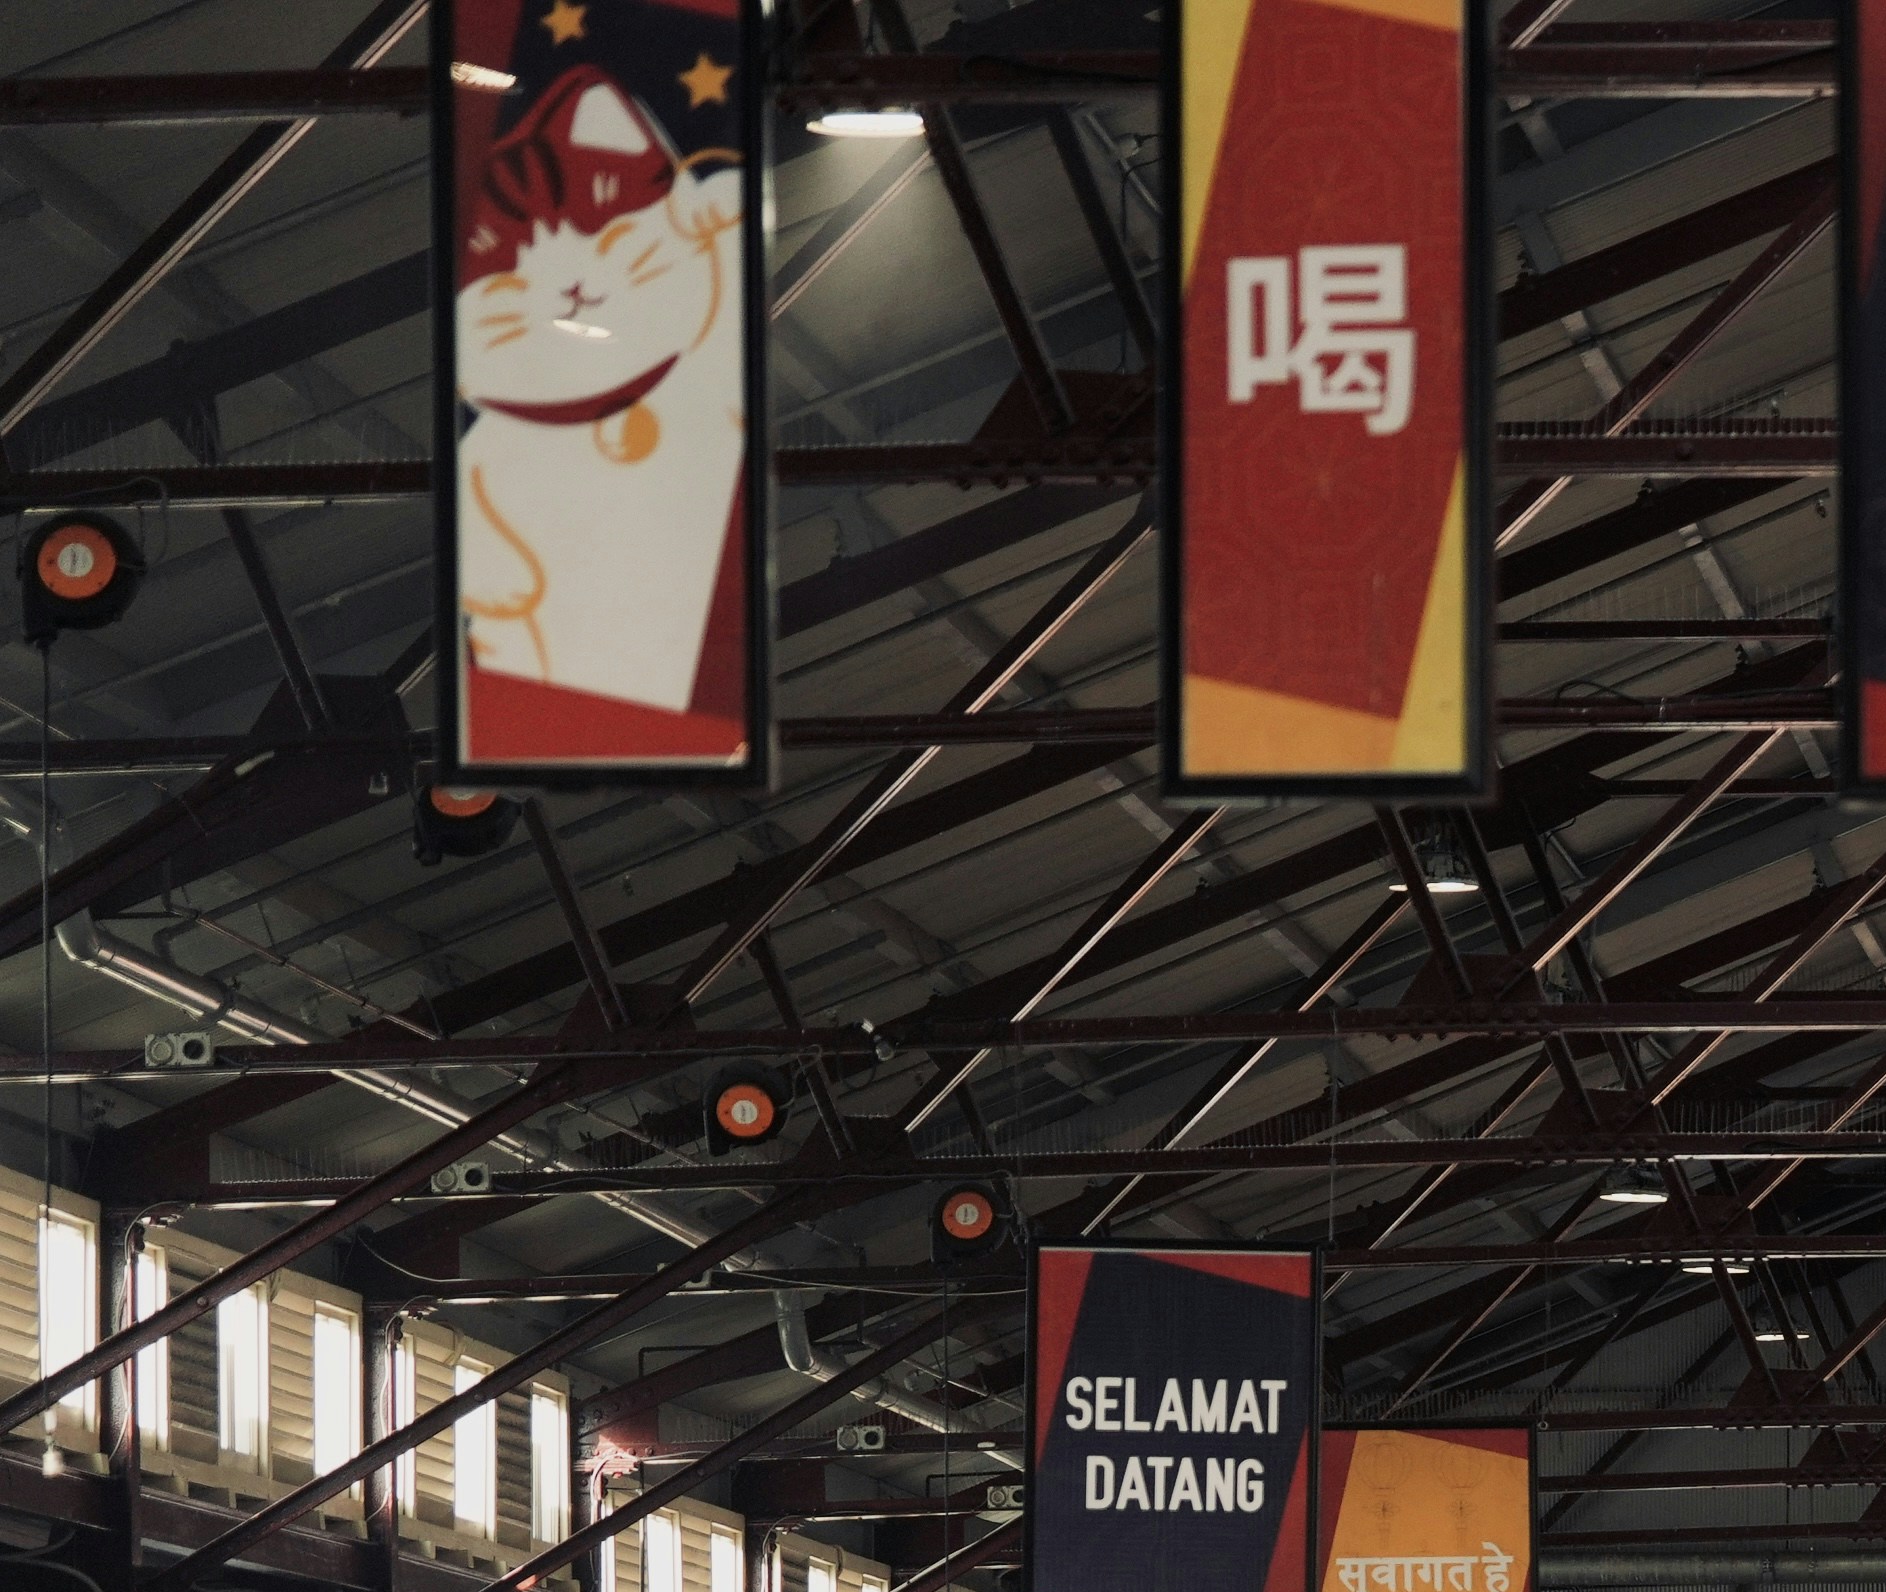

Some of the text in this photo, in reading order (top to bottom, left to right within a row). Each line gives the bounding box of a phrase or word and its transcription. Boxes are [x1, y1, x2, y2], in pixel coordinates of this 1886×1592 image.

[1225, 242, 1418, 436] 喝
[1064, 1375, 1287, 1435] SELAMAT
[1084, 1454, 1266, 1513] DATANG
